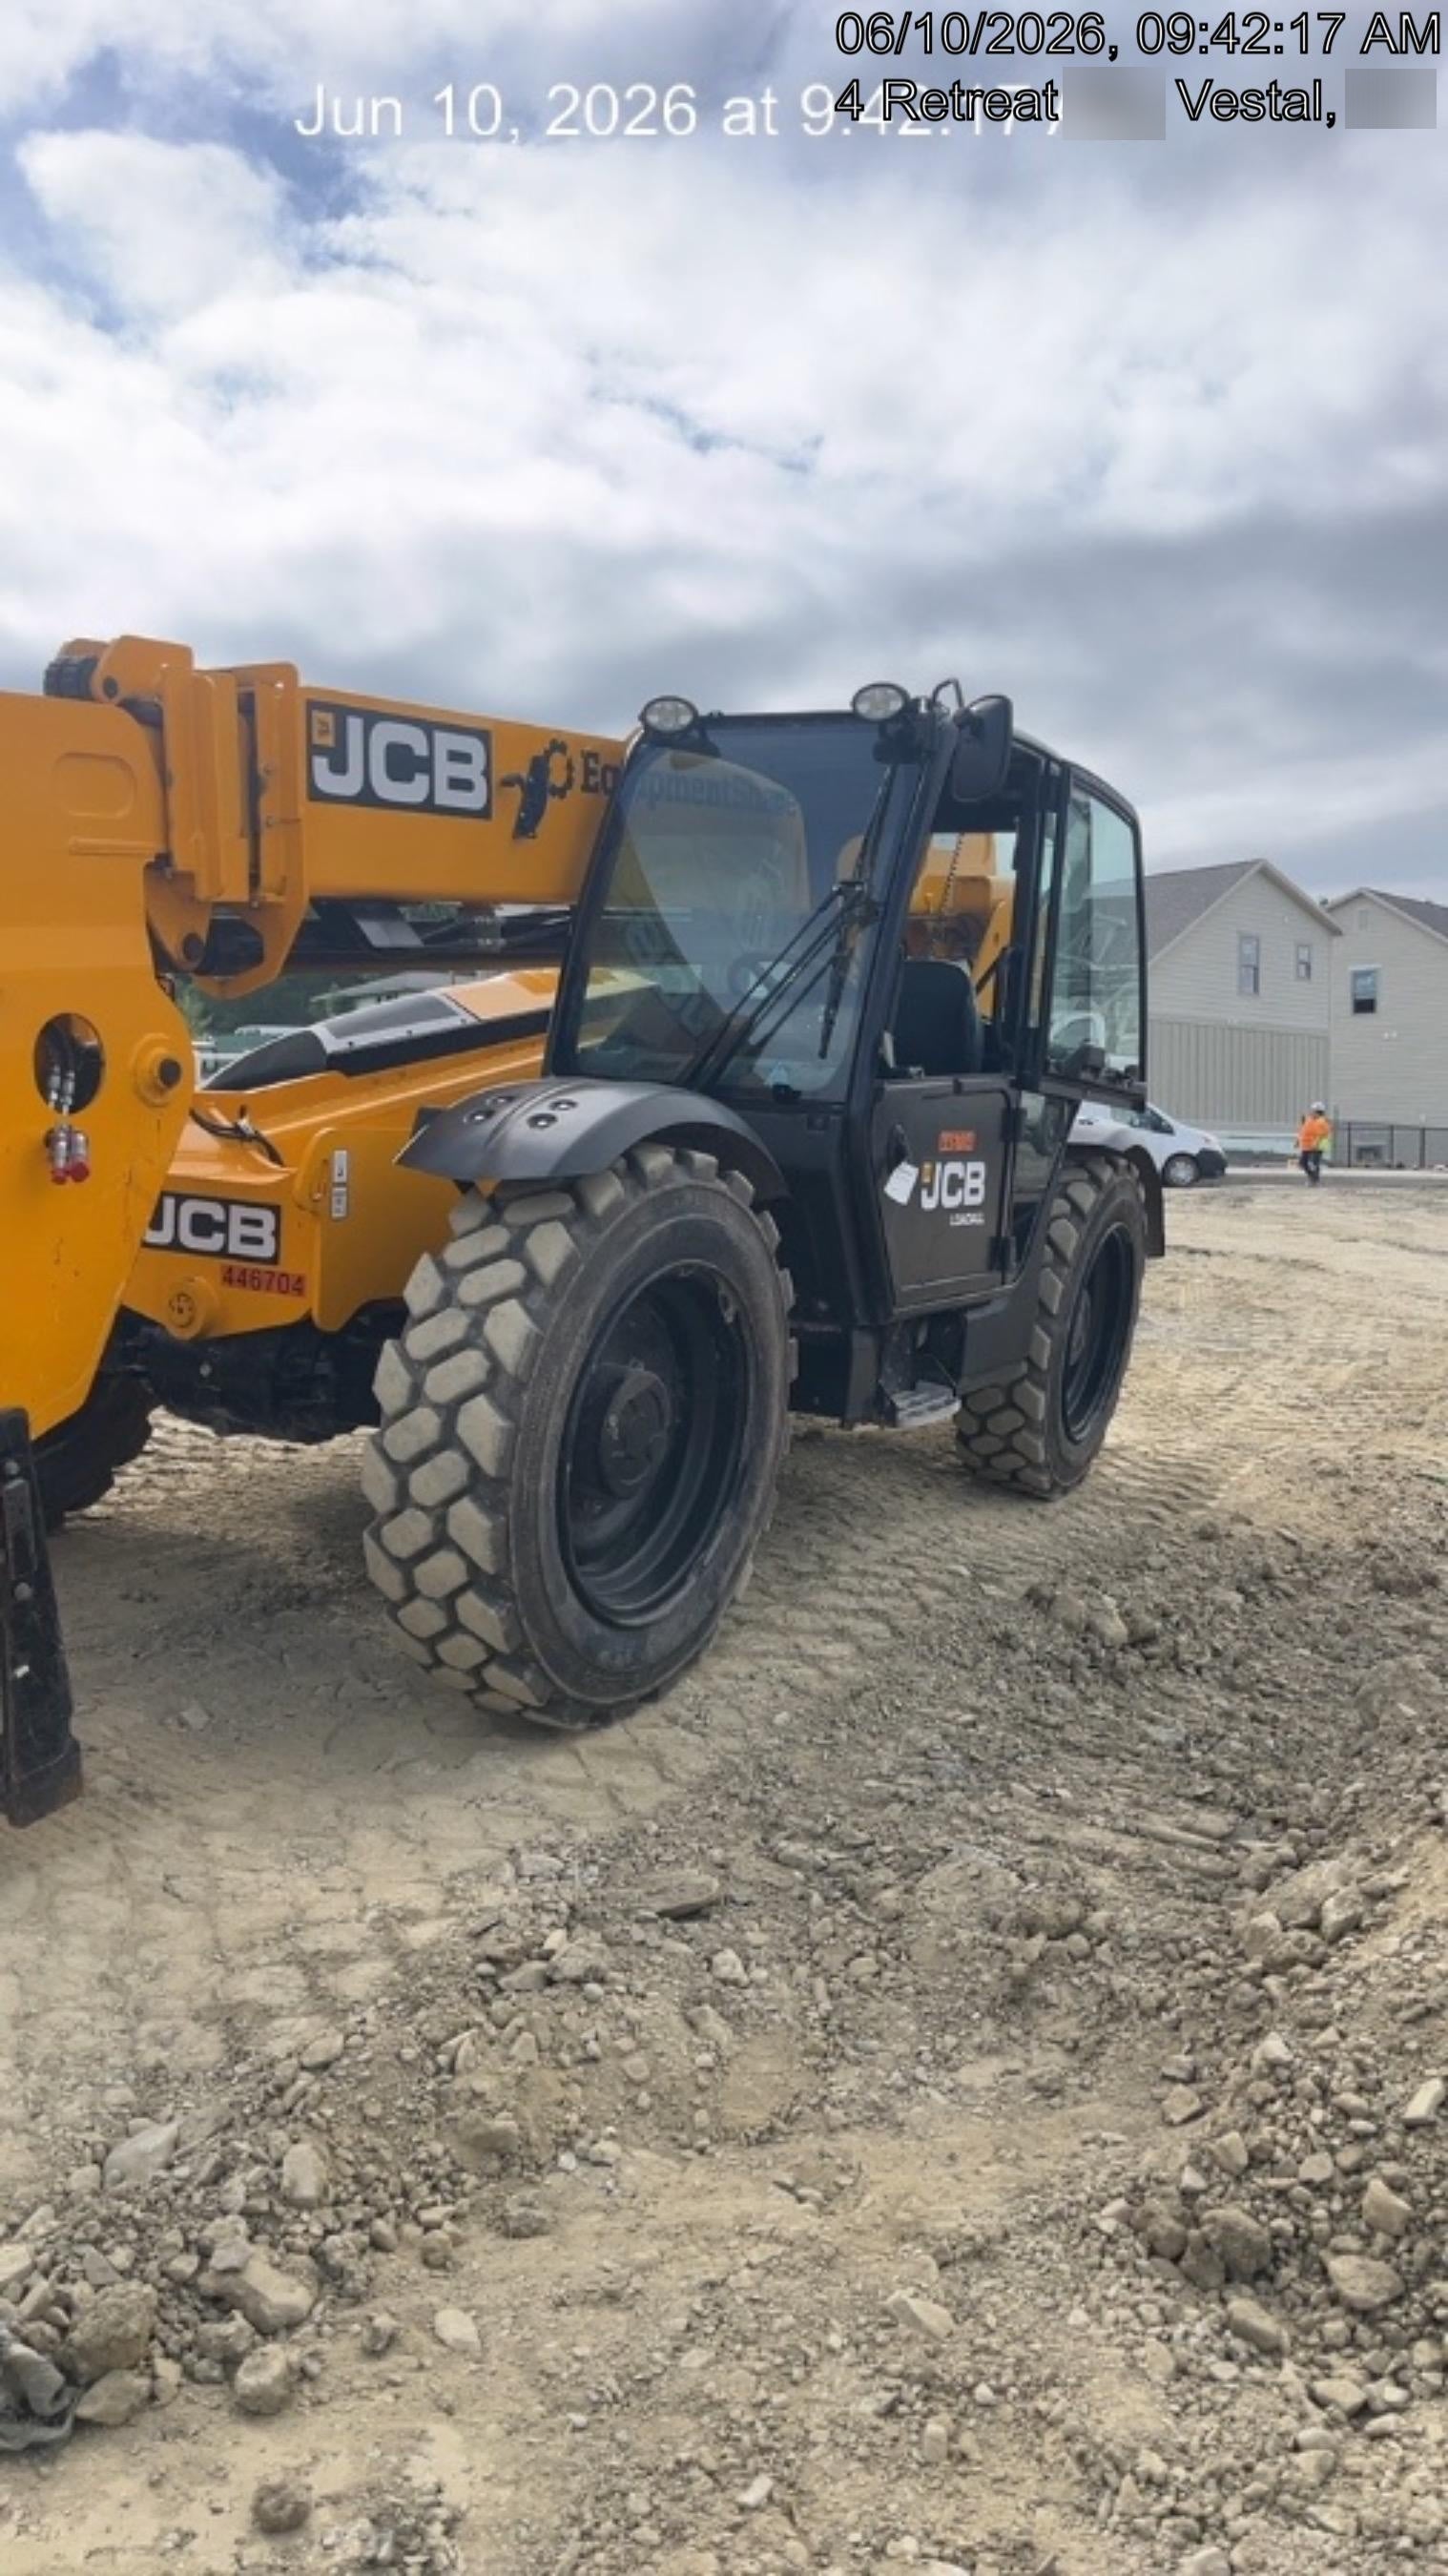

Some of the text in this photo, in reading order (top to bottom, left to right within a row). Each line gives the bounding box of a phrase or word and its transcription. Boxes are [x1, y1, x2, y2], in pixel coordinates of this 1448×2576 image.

[311, 714, 487, 811] JCB
[920, 1161, 986, 1210] JCB
[144, 1195, 277, 1258] JCB
[221, 1266, 306, 1297] 446704
